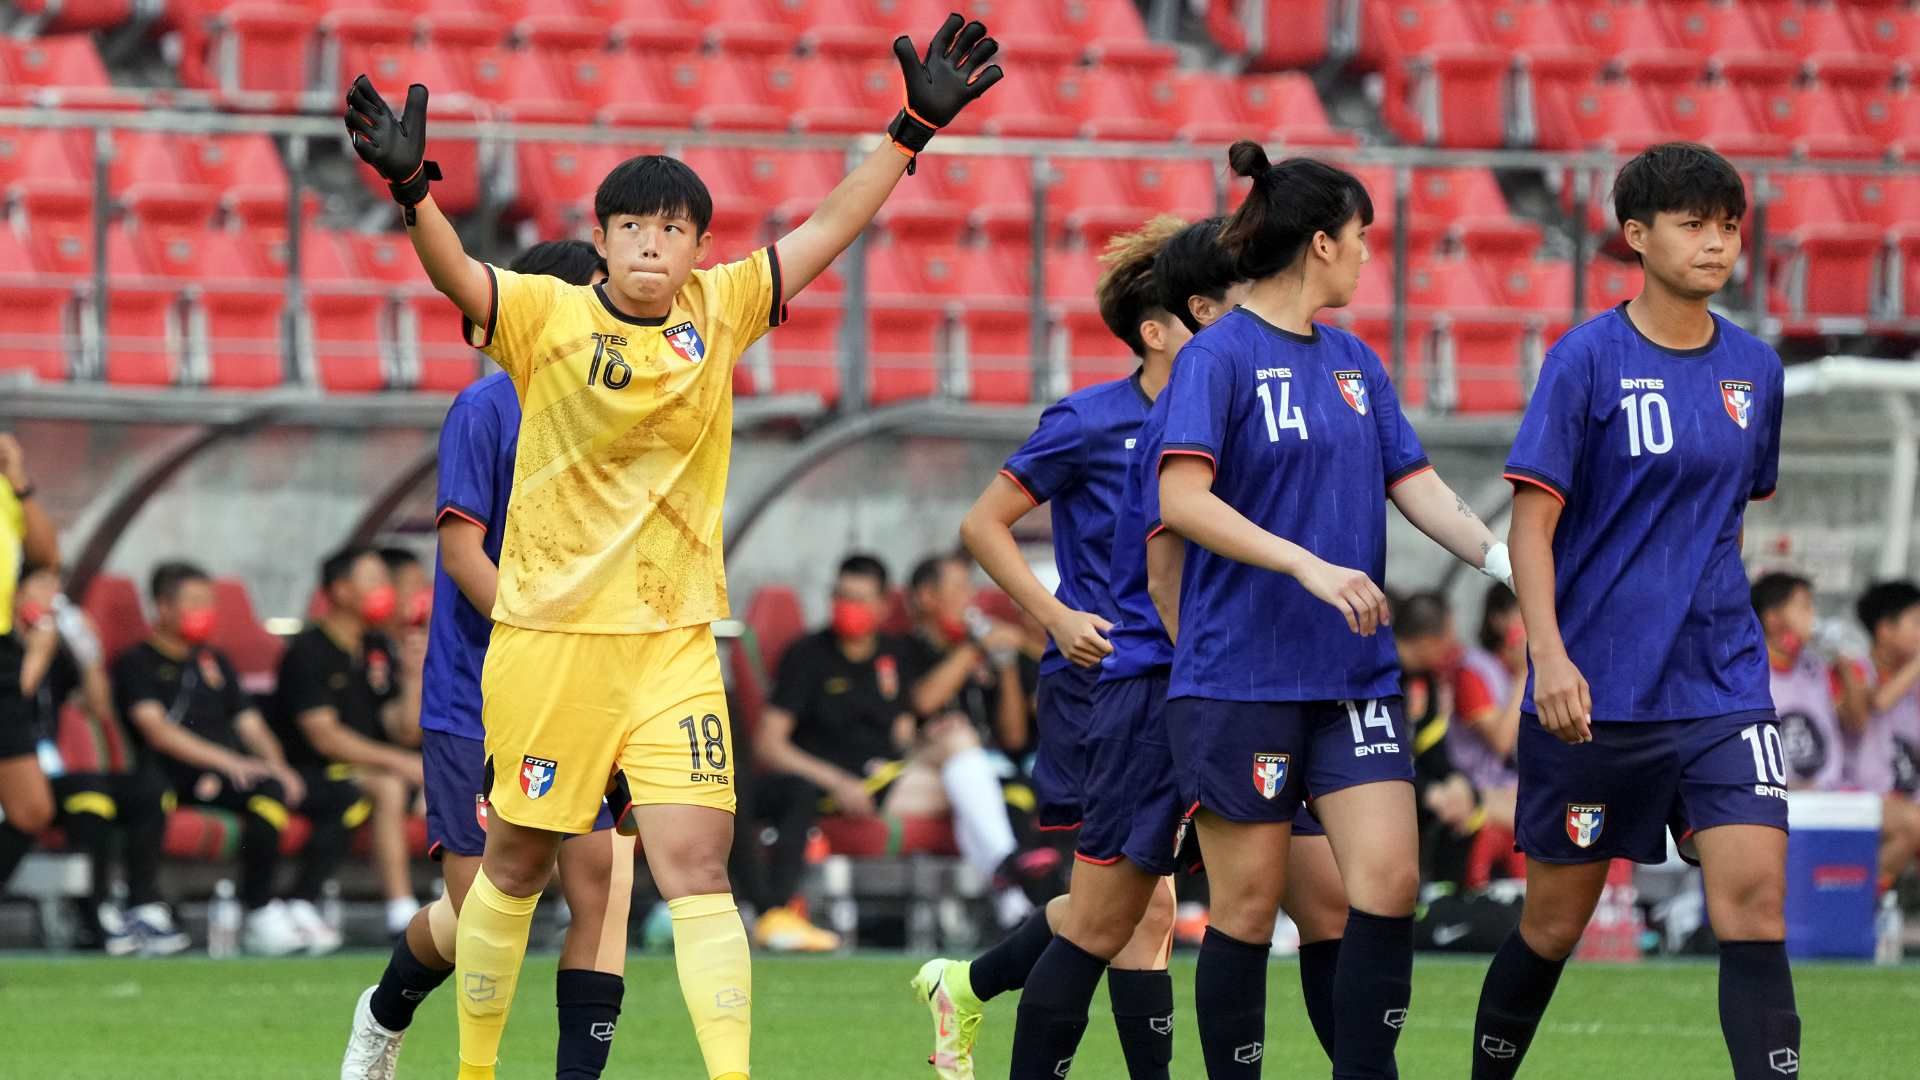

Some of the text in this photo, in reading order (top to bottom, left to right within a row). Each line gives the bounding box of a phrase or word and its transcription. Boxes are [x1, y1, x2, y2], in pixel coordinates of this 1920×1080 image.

[593, 333, 628, 346] TES
[1256, 368, 1292, 380] ENTES
[1621, 379, 1664, 389] ENTES
[1724, 383, 1751, 391] CTFA
[1256, 382, 1308, 443] 14
[1620, 392, 1673, 457] 10
[1337, 699, 1396, 743] 14
[679, 714, 726, 770] 18
[1354, 743, 1400, 757] ENTES
[1741, 724, 1787, 786] 10
[691, 773, 728, 785] ENTES
[1755, 784, 1788, 801] ENTE
